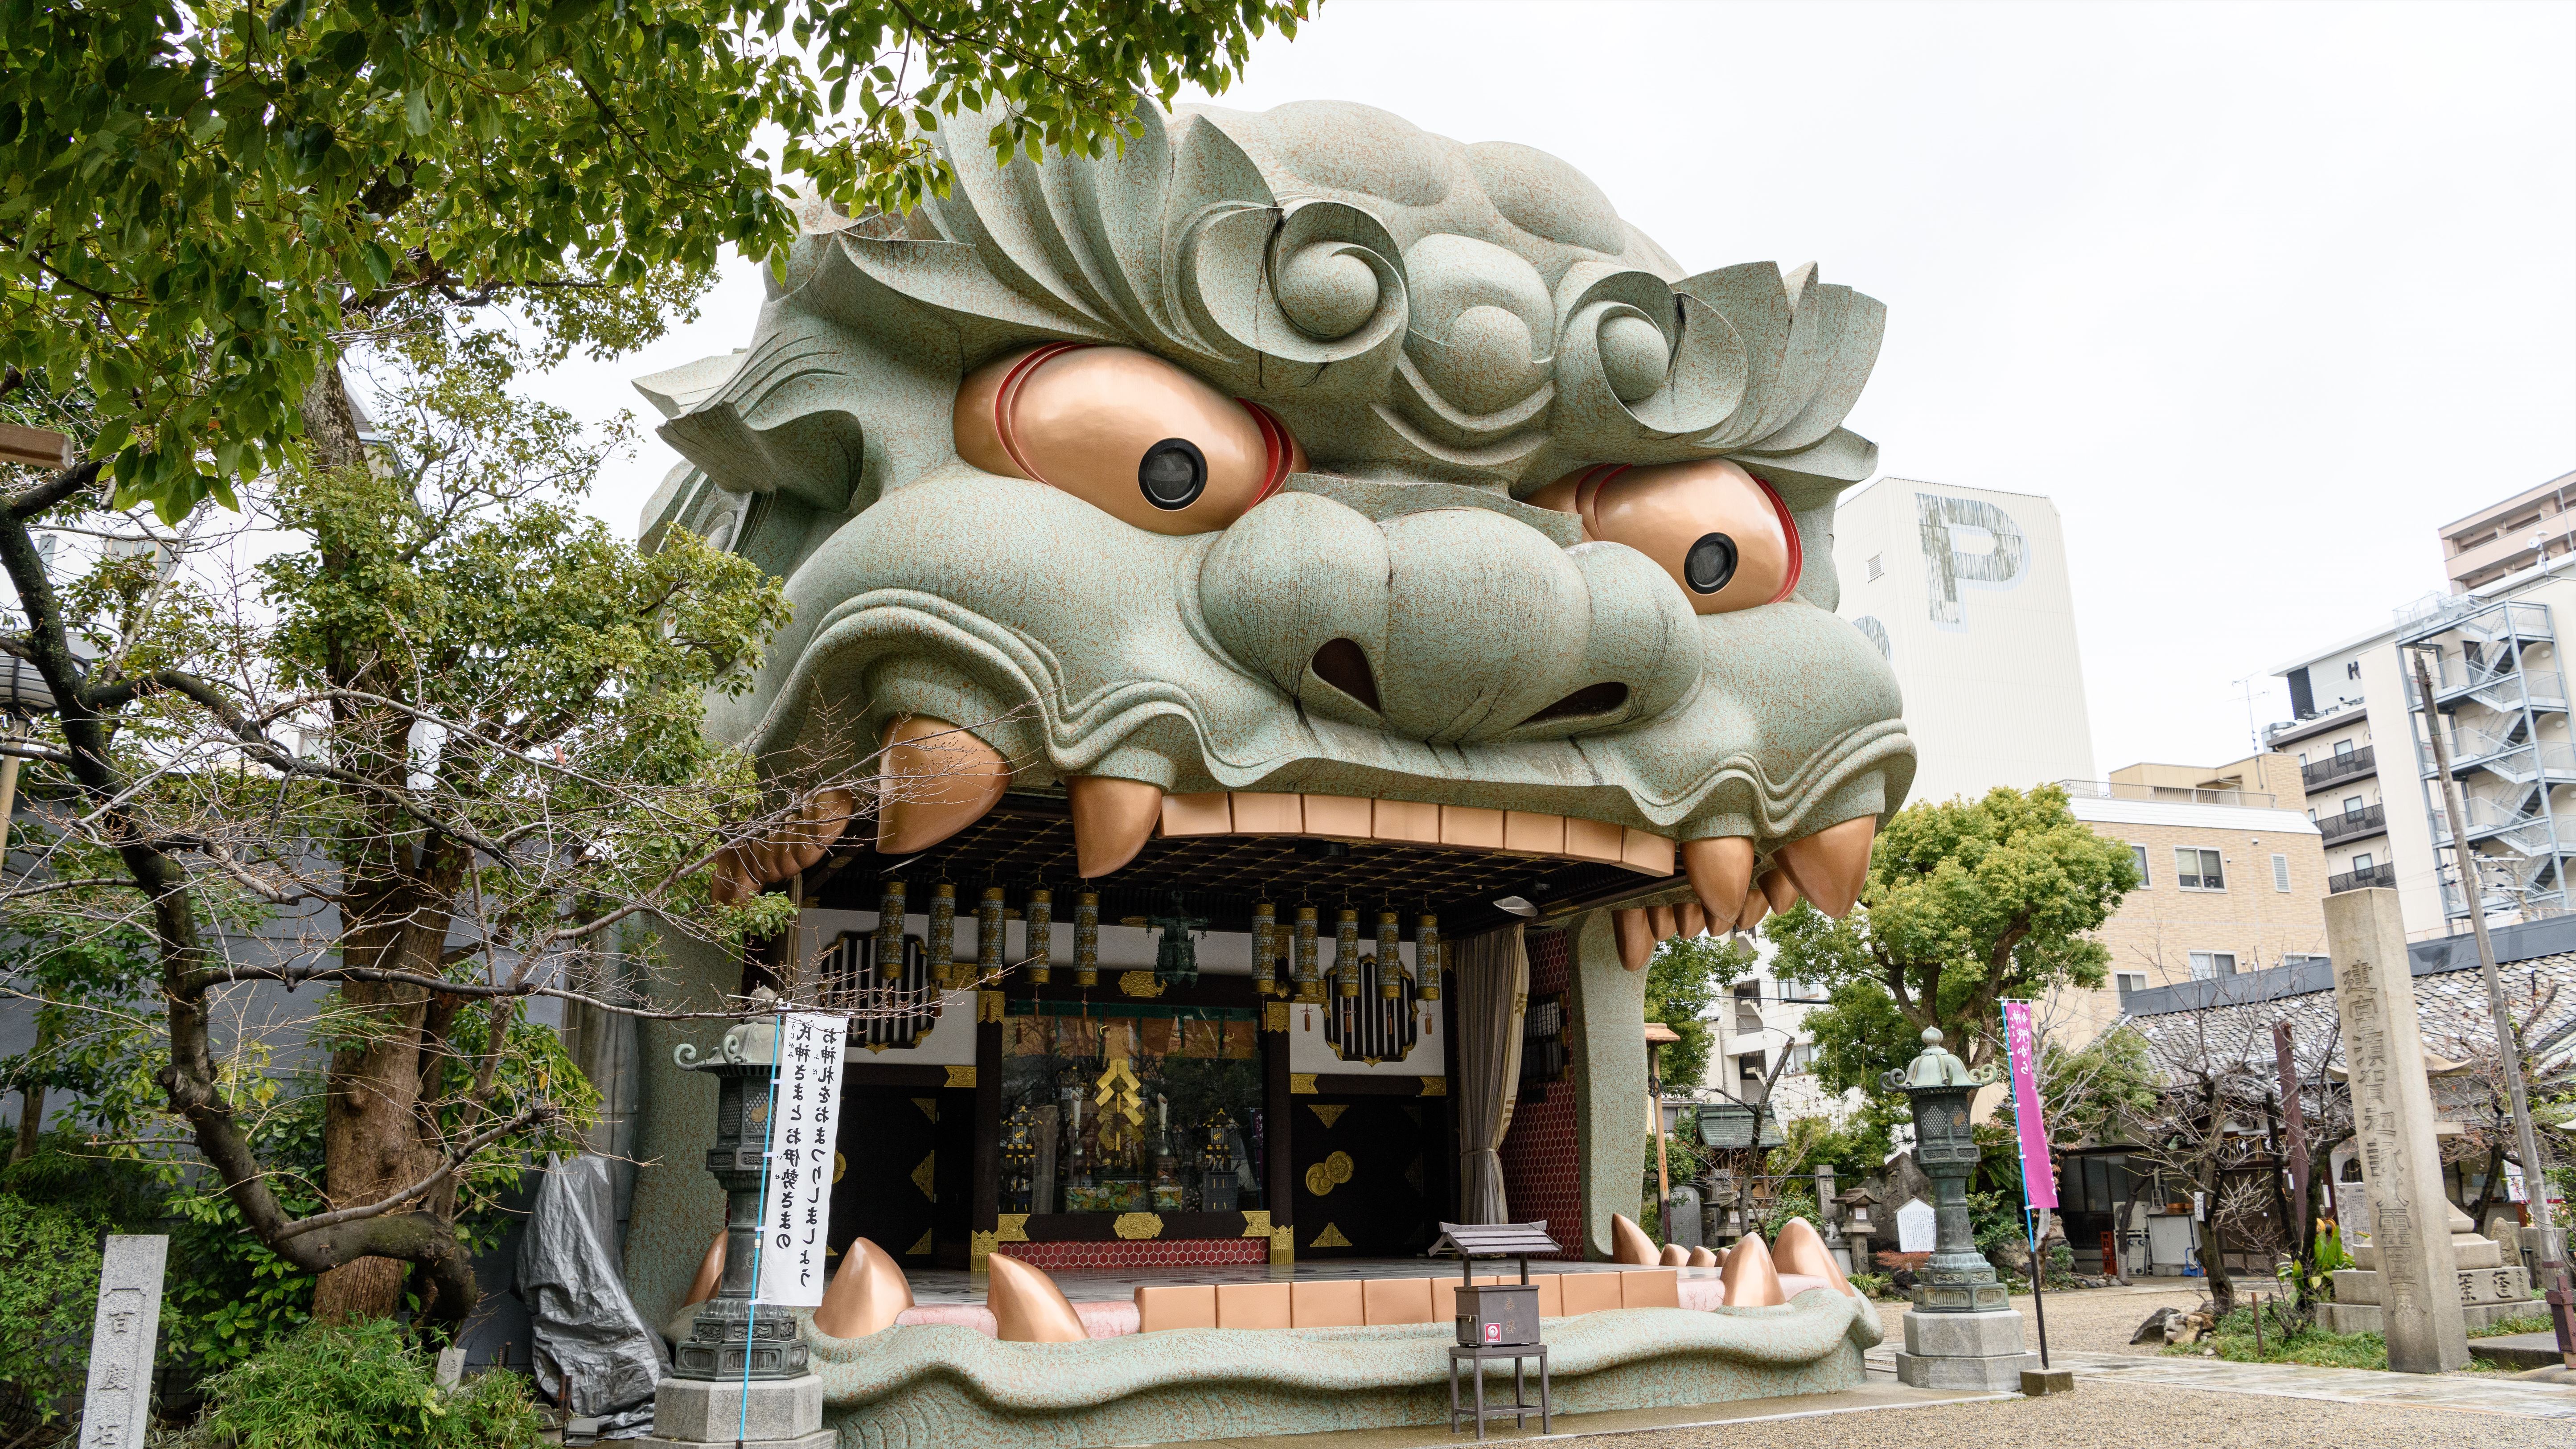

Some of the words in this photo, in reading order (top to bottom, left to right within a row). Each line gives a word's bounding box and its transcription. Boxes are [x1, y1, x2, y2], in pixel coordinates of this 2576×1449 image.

[1915, 493, 2028, 629] P
[91, 1310, 136, 1445] 百度石
